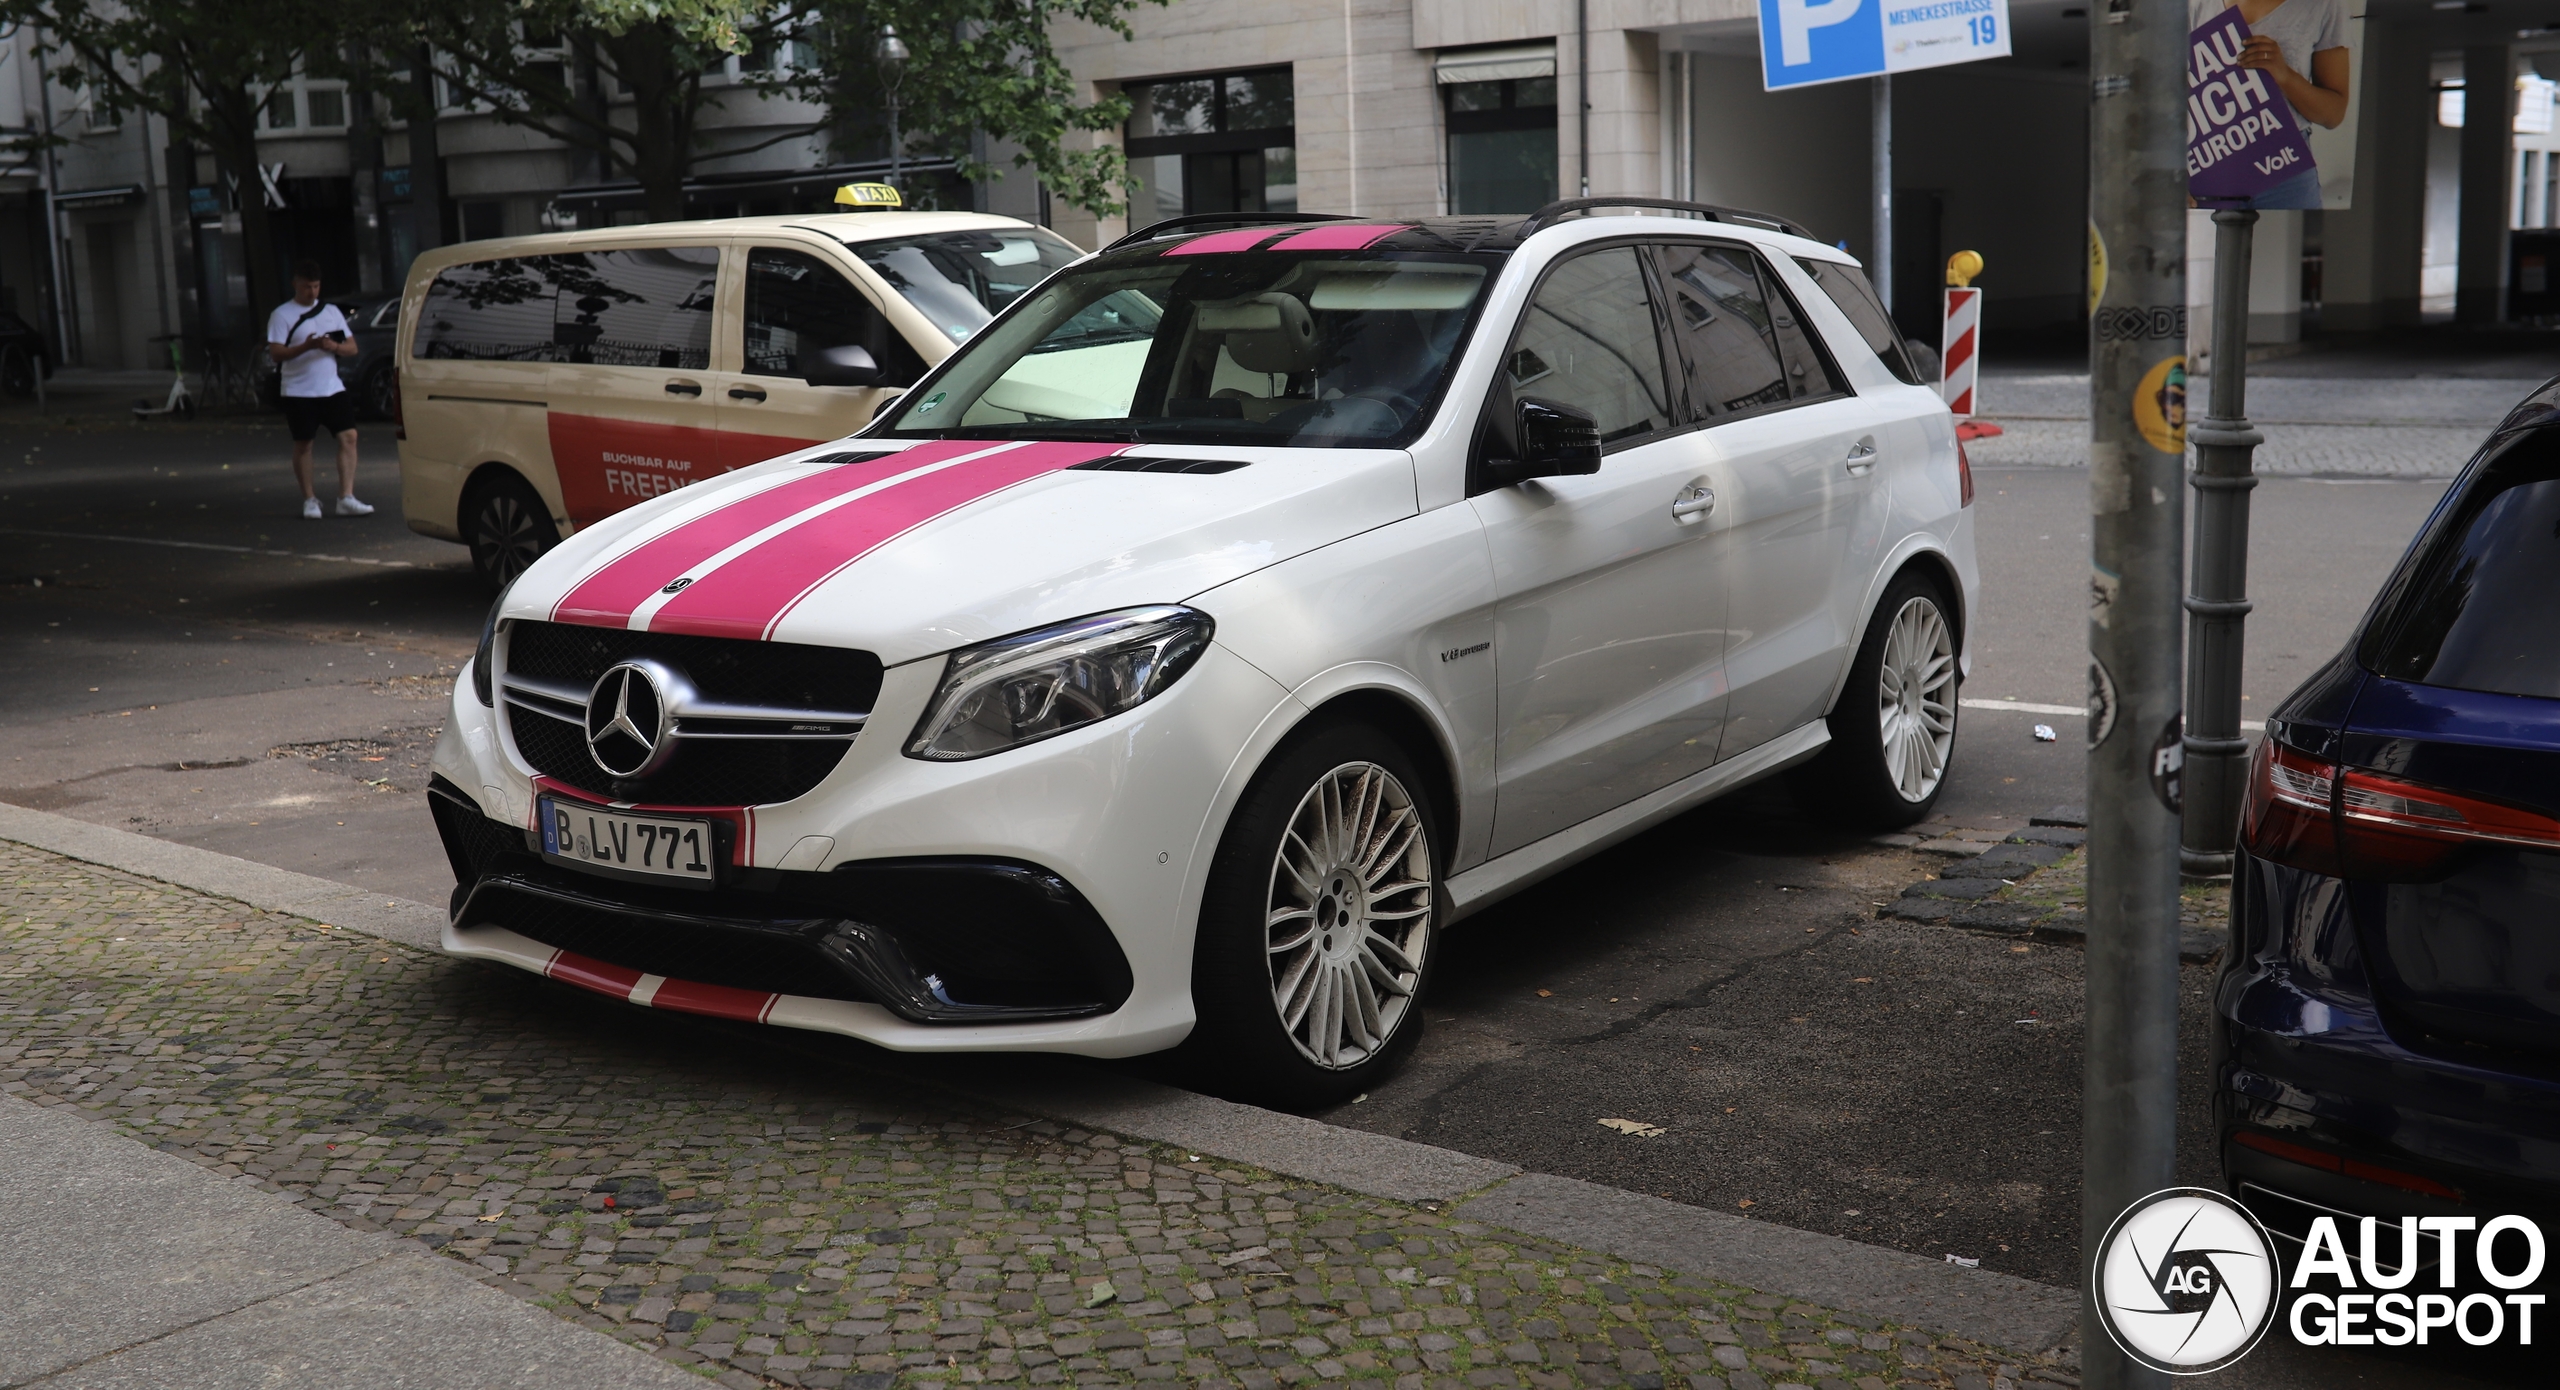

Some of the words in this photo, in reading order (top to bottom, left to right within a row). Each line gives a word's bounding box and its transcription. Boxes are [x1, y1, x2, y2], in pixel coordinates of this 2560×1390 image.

[1889, 0, 1993, 26] MEINEKESTRASSE
[1777, 0, 1862, 67] P
[1967, 15, 1996, 46] 19
[2187, 108, 2283, 178] EUROPA
[2254, 146, 2300, 176] Volt
[857, 187, 895, 201] TAXI
[602, 451, 663, 469] BUCHBAR
[666, 459, 692, 472] AUF
[547, 831, 554, 844] D
[555, 808, 573, 851] B
[588, 816, 628, 864] LV
[636, 823, 708, 873] 771
